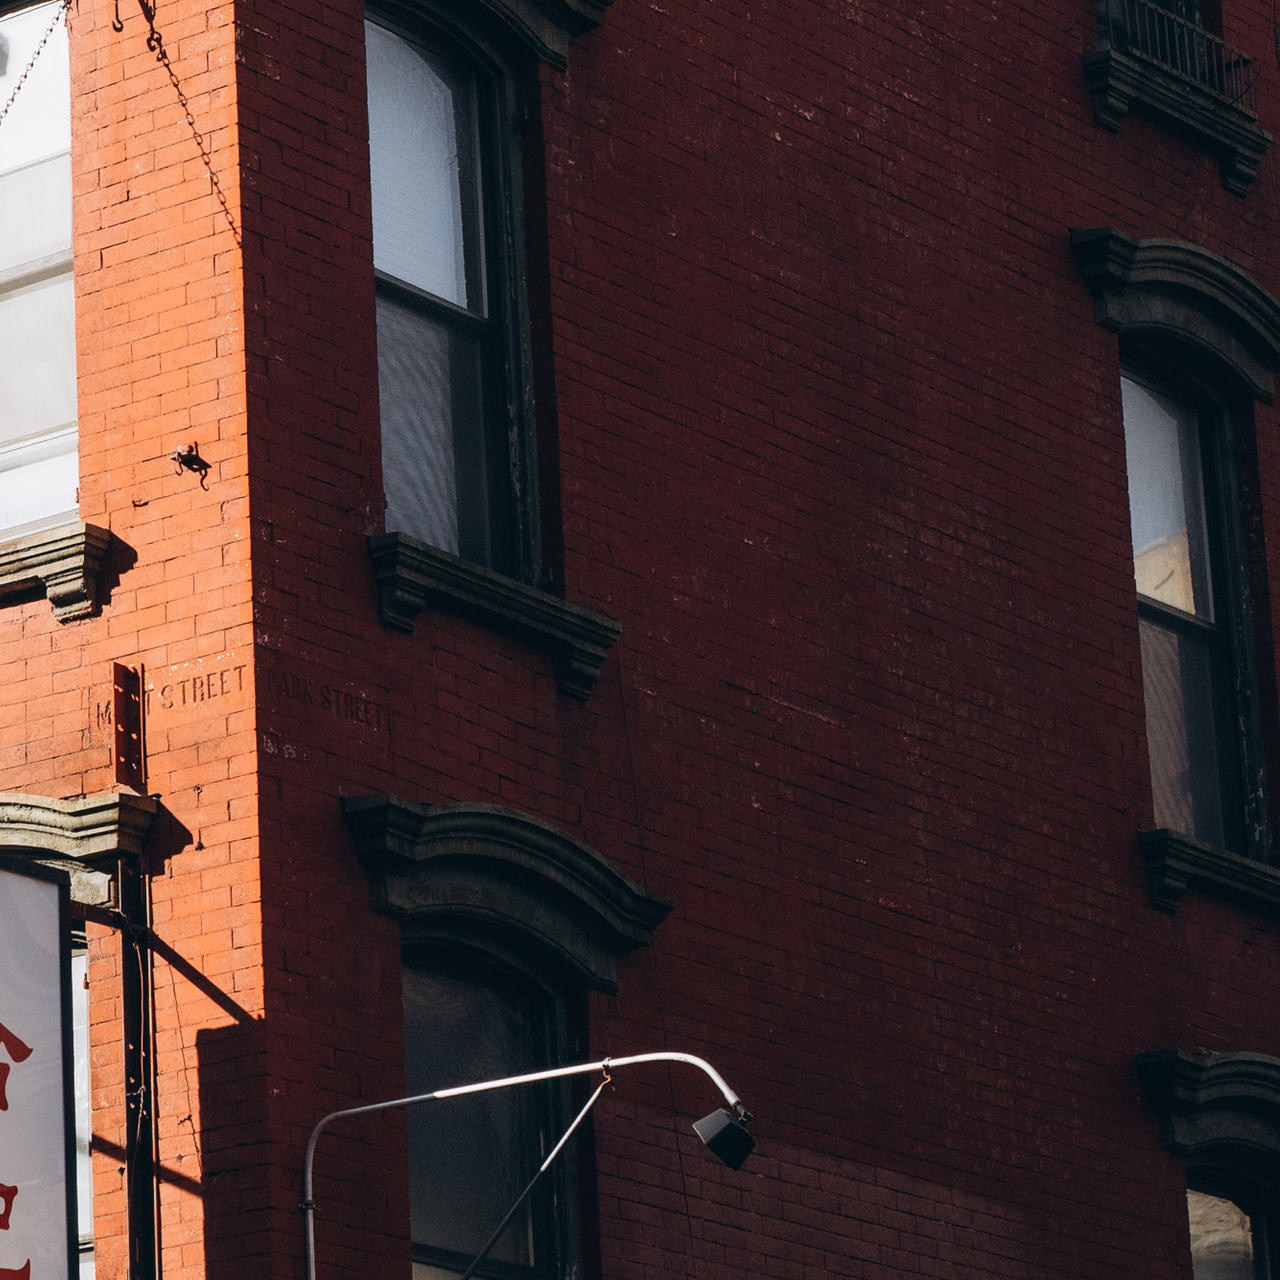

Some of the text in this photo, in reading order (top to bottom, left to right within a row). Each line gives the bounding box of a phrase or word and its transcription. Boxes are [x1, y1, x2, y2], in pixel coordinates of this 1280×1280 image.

[97, 664, 248, 731] MT STREET
[266, 668, 385, 728] PARK STREET
